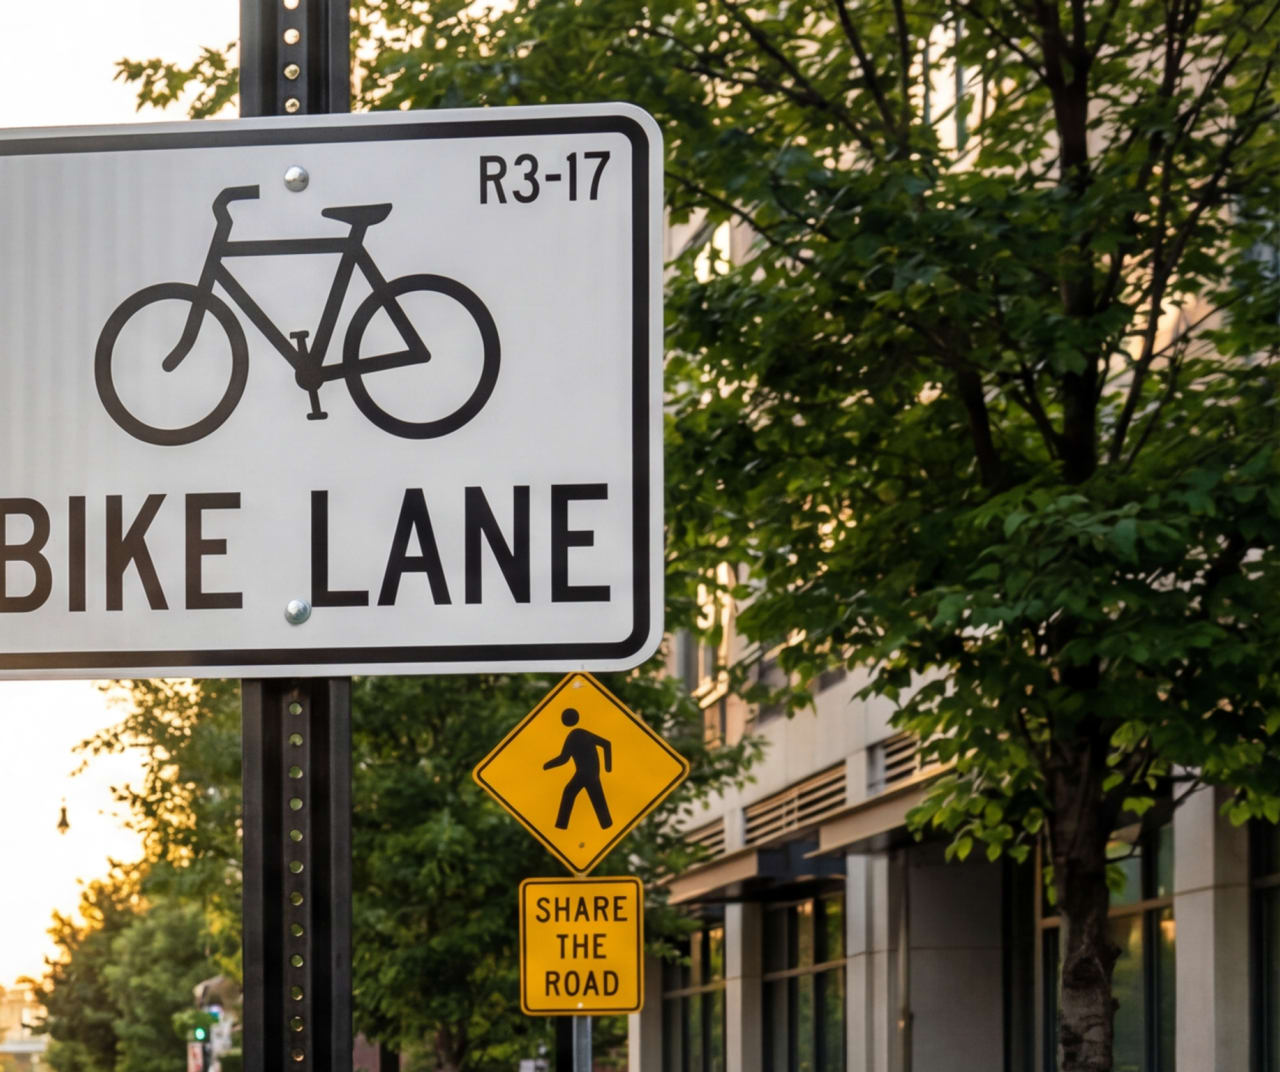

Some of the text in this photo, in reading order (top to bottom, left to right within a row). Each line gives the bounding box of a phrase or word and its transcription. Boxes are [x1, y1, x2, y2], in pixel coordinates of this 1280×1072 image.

[479, 150, 611, 204] R3-17
[309, 482, 612, 608] LANE
[535, 895, 628, 924] SHARE
[556, 933, 607, 960] THE
[545, 969, 620, 997] ROAD
